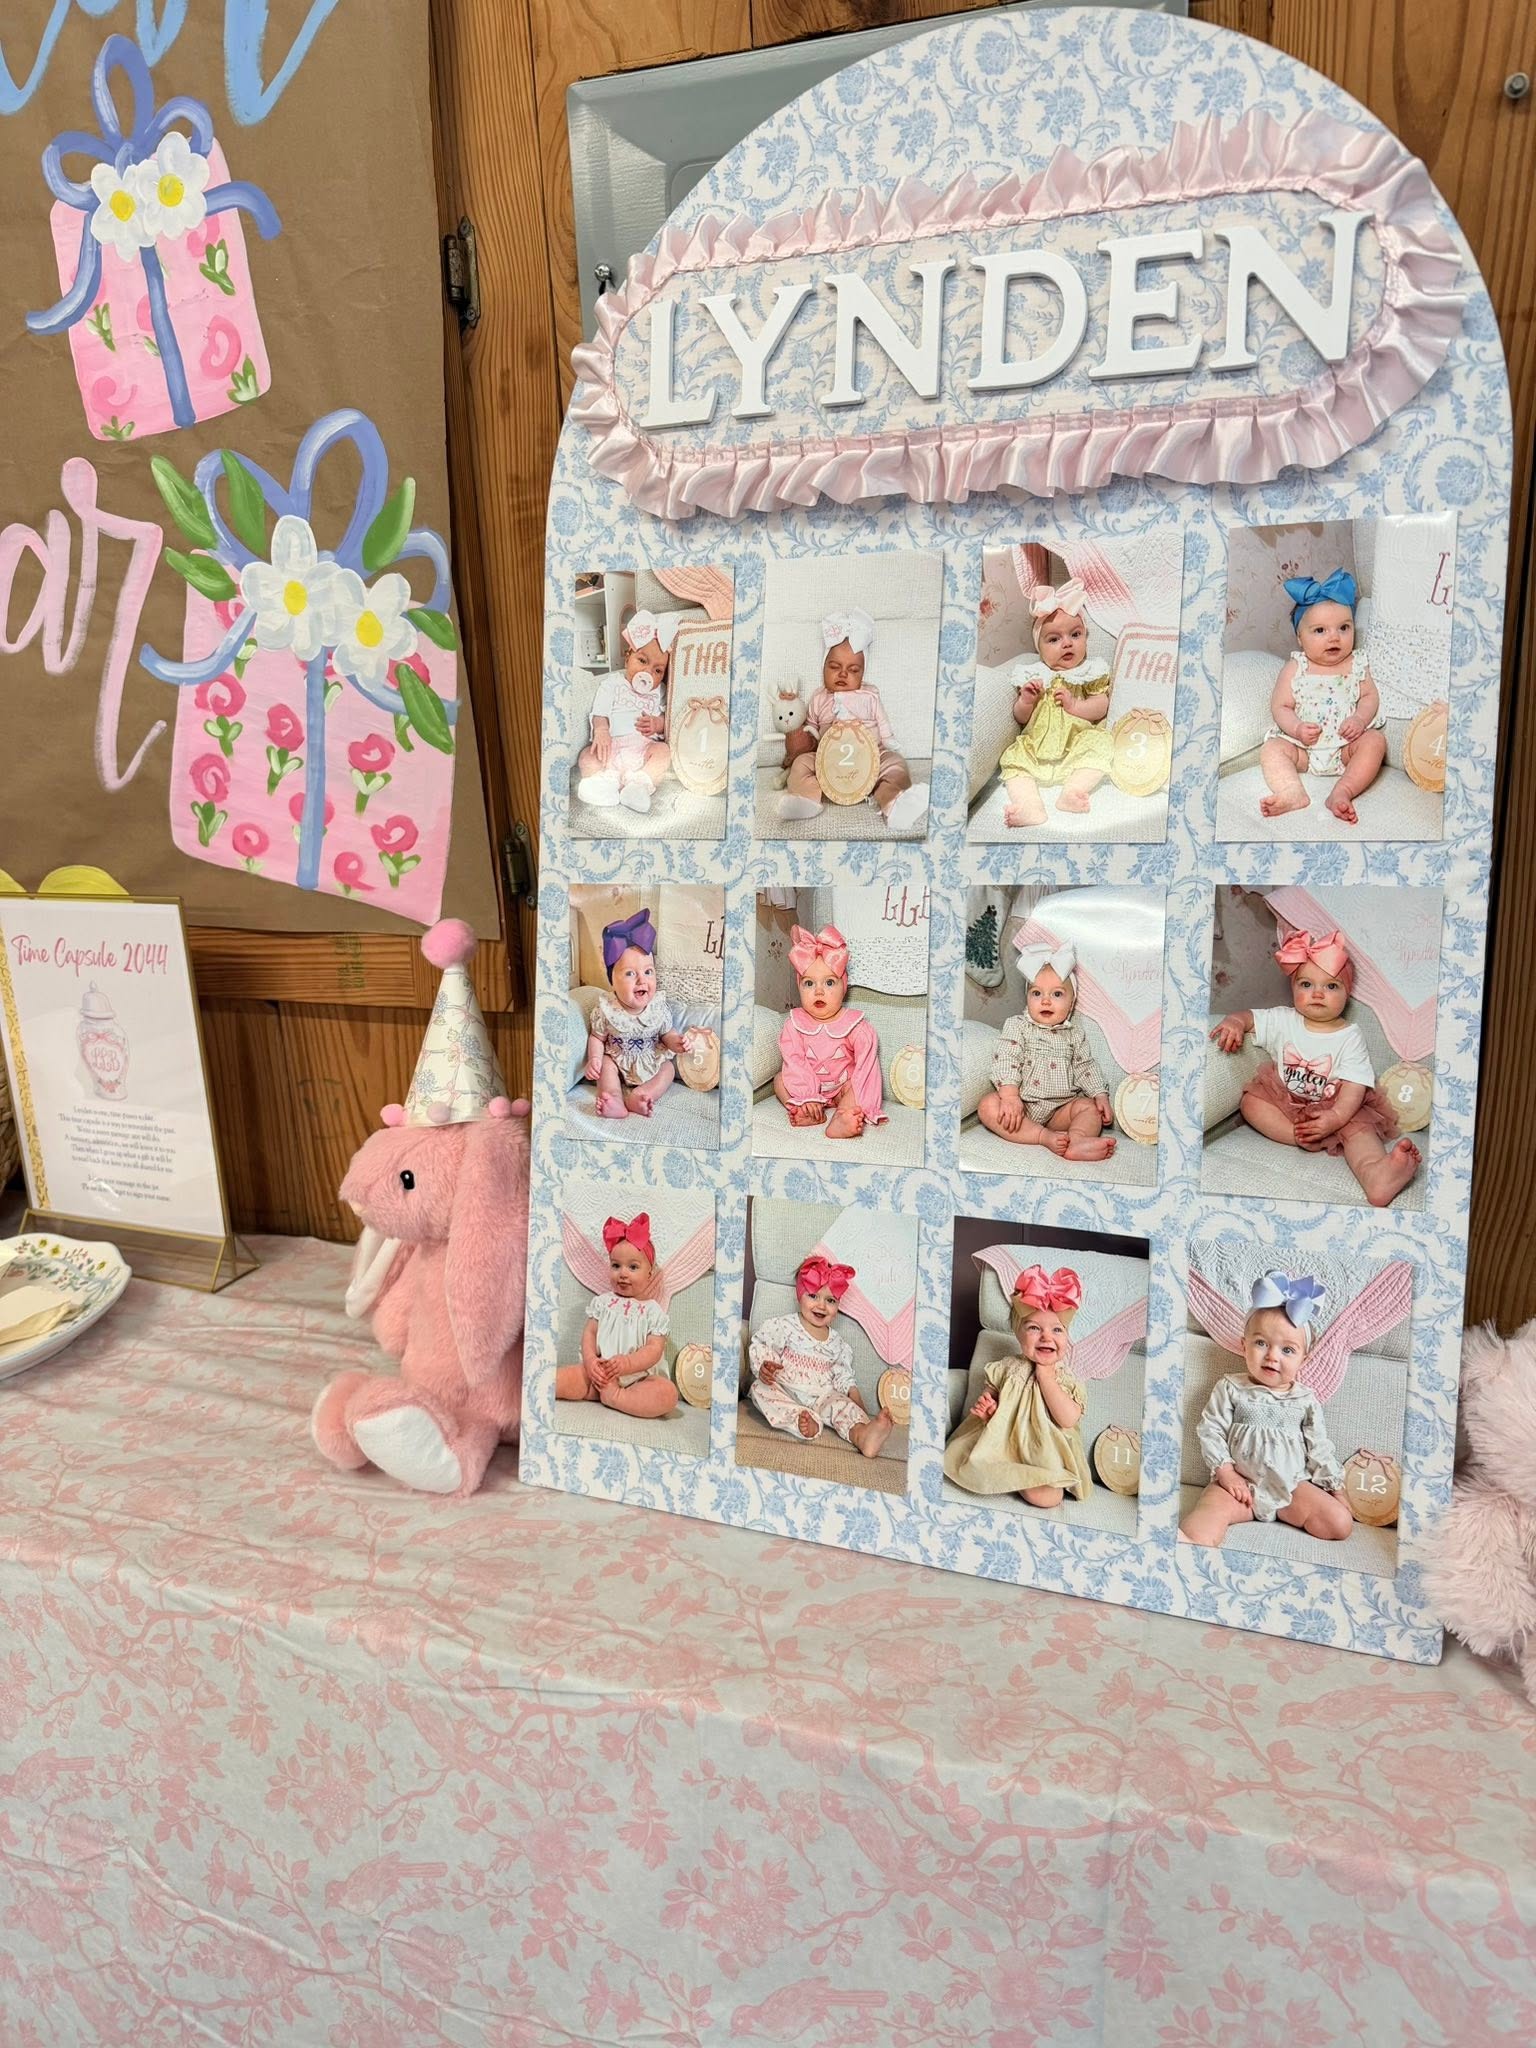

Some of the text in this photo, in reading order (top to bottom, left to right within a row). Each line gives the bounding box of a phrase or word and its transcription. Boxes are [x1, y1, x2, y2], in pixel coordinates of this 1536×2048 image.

[637, 211, 1376, 432] LYNDEN
[1124, 649, 1177, 684] THA
[698, 727, 709, 753] 1
[1126, 732, 1147, 759] 3
[1429, 734, 1445, 757] 4
[838, 743, 855, 766] 2
[11, 934, 168, 977] Time Capsule 2044
[692, 1049, 705, 1066] 5
[906, 1063, 921, 1082] 6
[1283, 1066, 1328, 1086] ynden
[1136, 1092, 1153, 1114] 7
[1397, 1084, 1414, 1103] 8
[694, 1362, 705, 1378] 9
[890, 1383, 911, 1401] 10
[1111, 1446, 1132, 1466] 11
[1356, 1472, 1387, 1495] 12
